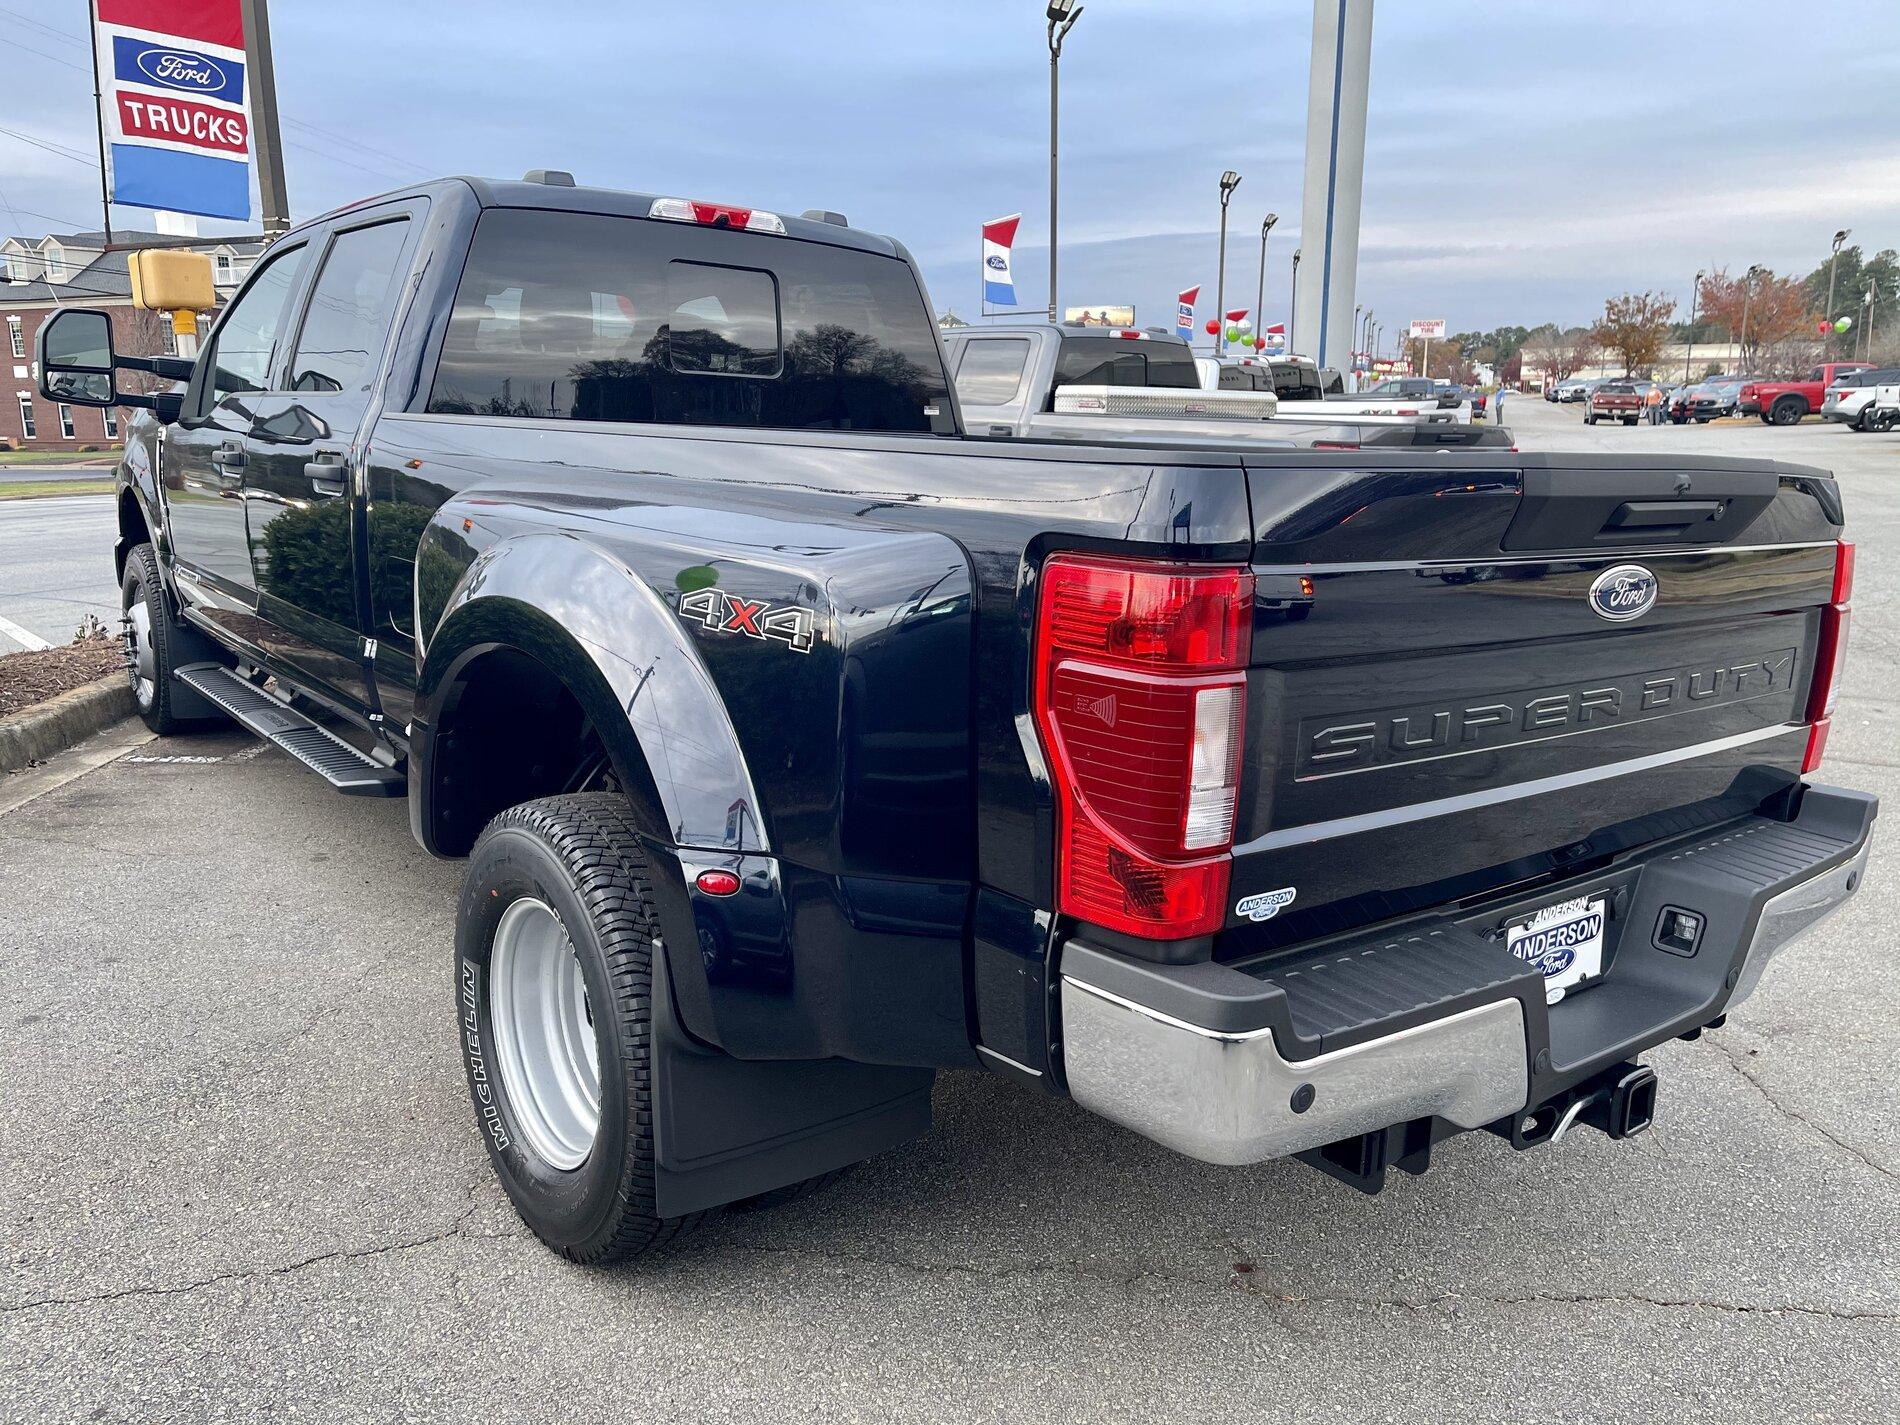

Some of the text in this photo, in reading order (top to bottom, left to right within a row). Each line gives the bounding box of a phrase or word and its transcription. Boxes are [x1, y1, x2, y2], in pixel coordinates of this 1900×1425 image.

[156, 54, 211, 86] Ford
[123, 100, 244, 146] TRUCKS
[1411, 320, 1444, 328] DISCOUNT
[1610, 576, 1648, 608] Ford
[1310, 654, 1793, 761] SUPER DUTY
[1239, 890, 1293, 912] ANDERSON
[1534, 895, 1589, 925] ANDERSON
[1512, 915, 1599, 961] ANDERSON
[1540, 951, 1569, 975] Ford
[462, 962, 510, 1152] MICHELIN
